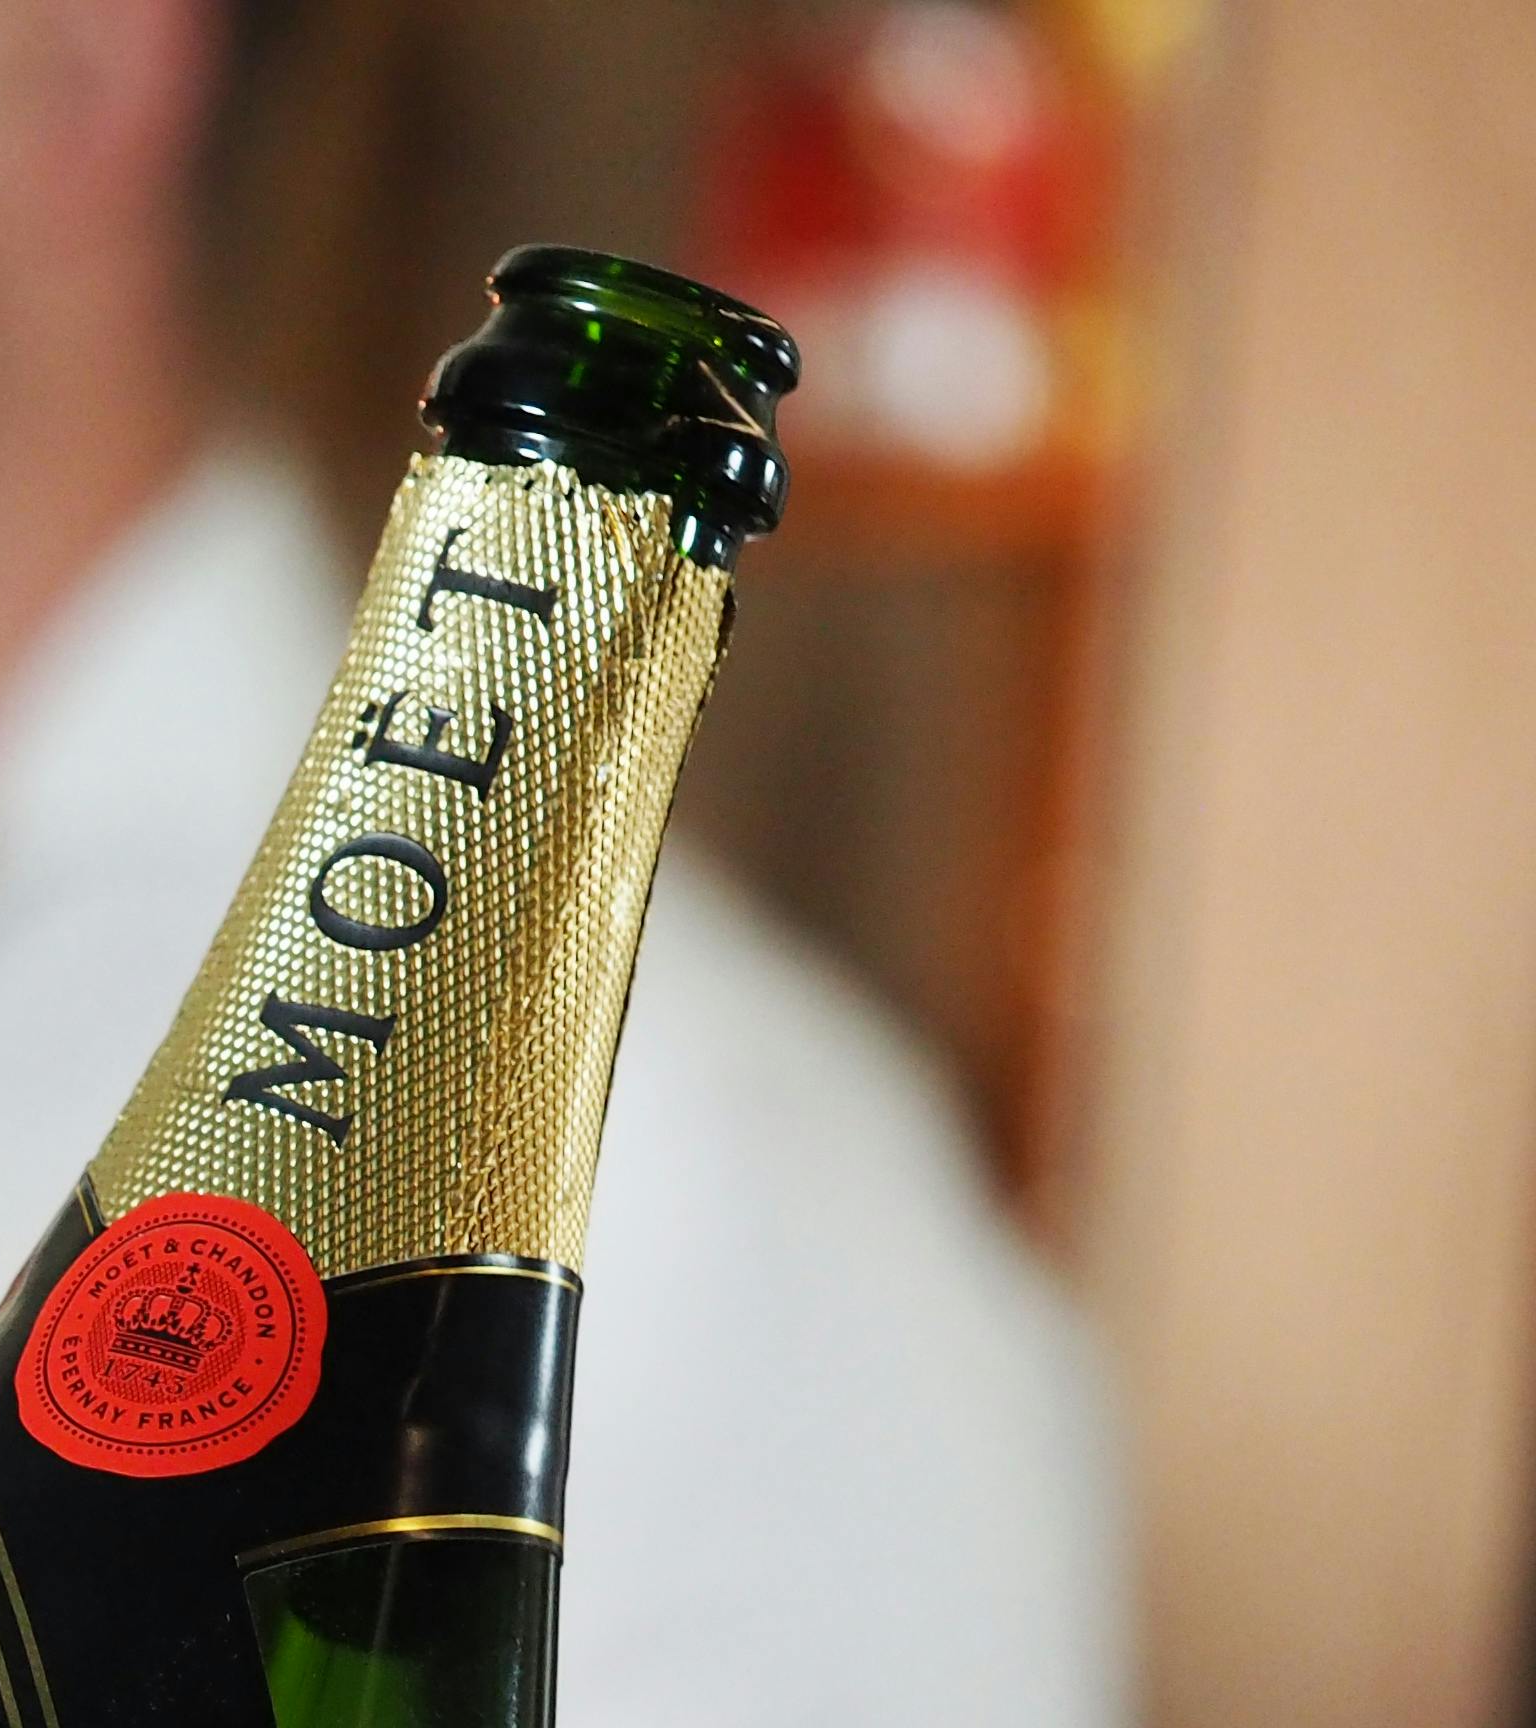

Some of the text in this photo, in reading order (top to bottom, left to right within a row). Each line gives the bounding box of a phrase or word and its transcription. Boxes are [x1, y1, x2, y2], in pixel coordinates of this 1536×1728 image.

[221, 527, 558, 1149] MOËT
[163, 1238, 180, 1254] &
[190, 1238, 276, 1339] CHANDON
[99, 1357, 187, 1395] 1743
[137, 1376, 254, 1430] FRANCE
